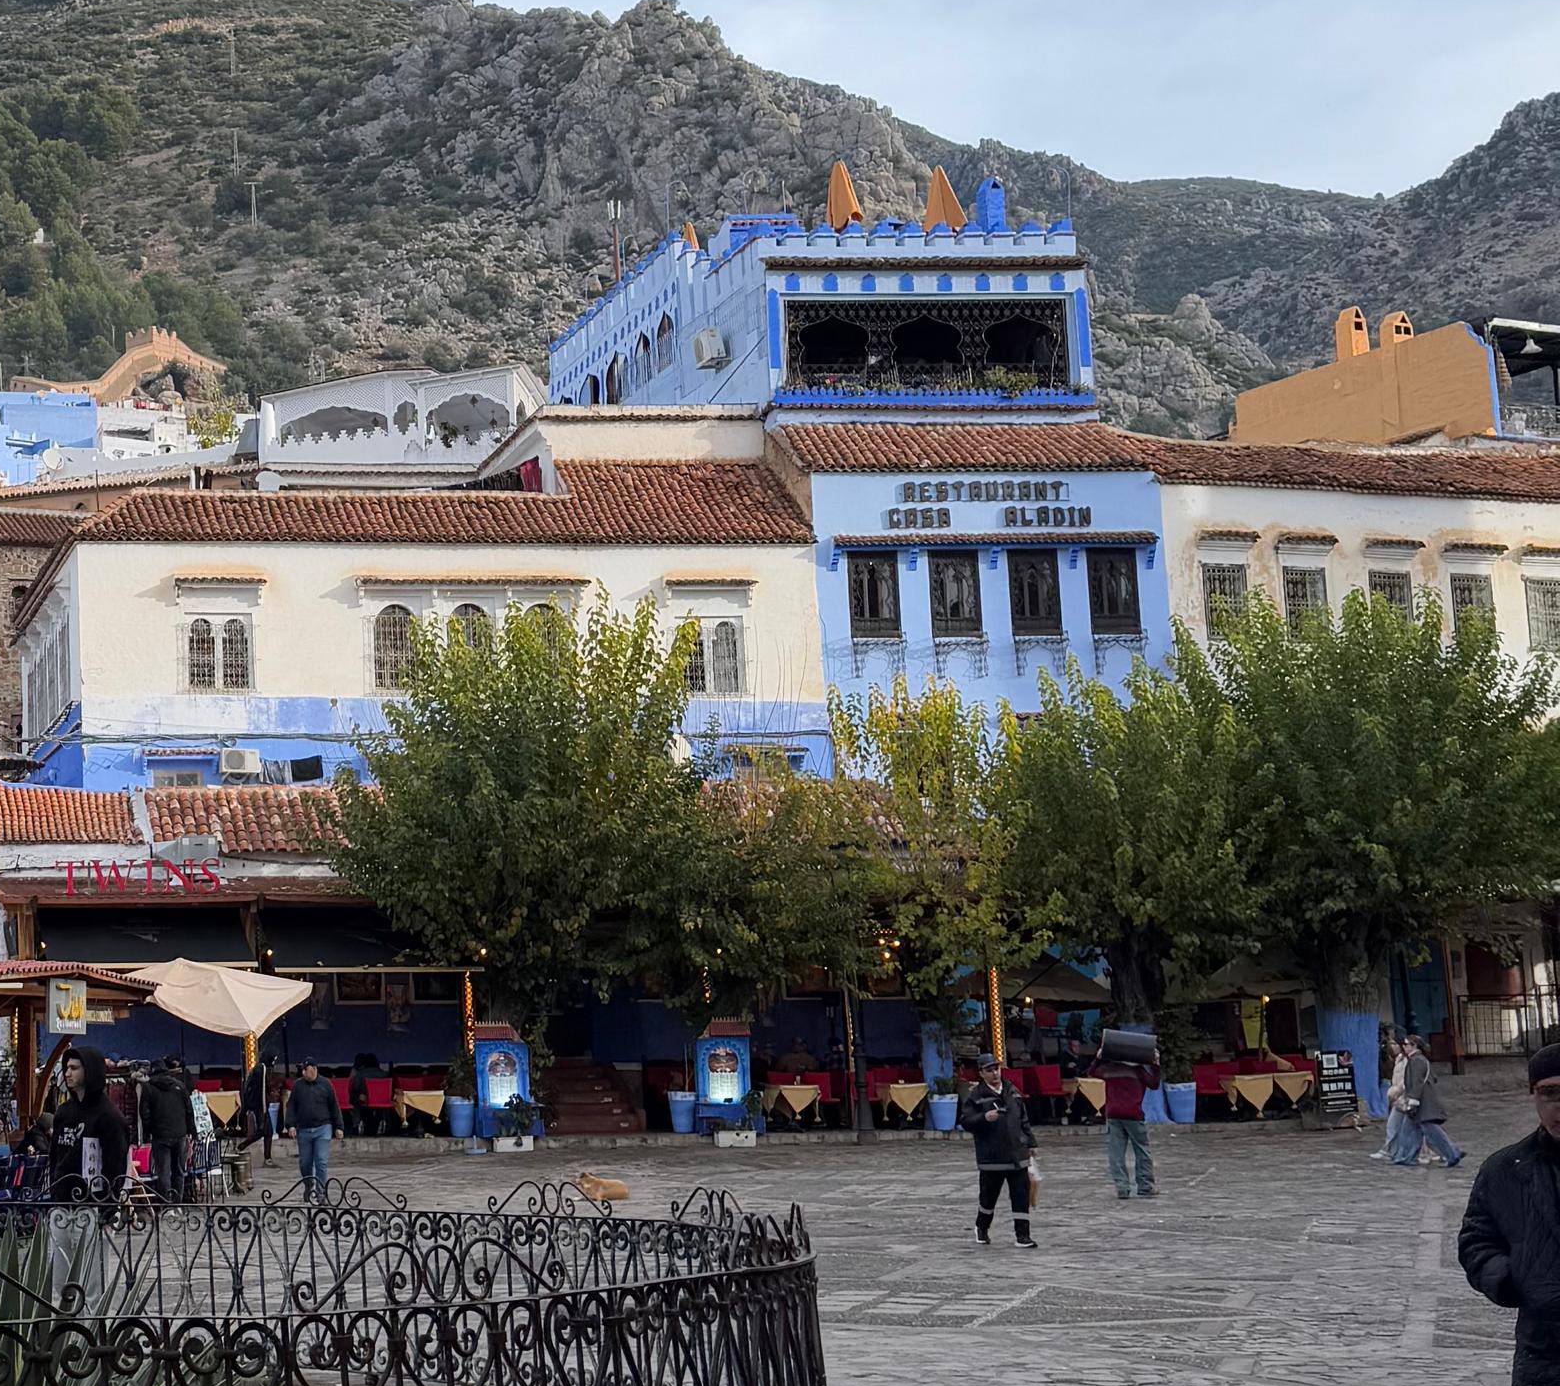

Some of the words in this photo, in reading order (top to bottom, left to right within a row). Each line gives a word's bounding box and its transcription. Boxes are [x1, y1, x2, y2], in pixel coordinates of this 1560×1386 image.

[903, 480, 1064, 502] RESTAURANT
[888, 507, 951, 529] CASA
[1004, 506, 1091, 528] ALADIN
[54, 858, 220, 896] TWINS
